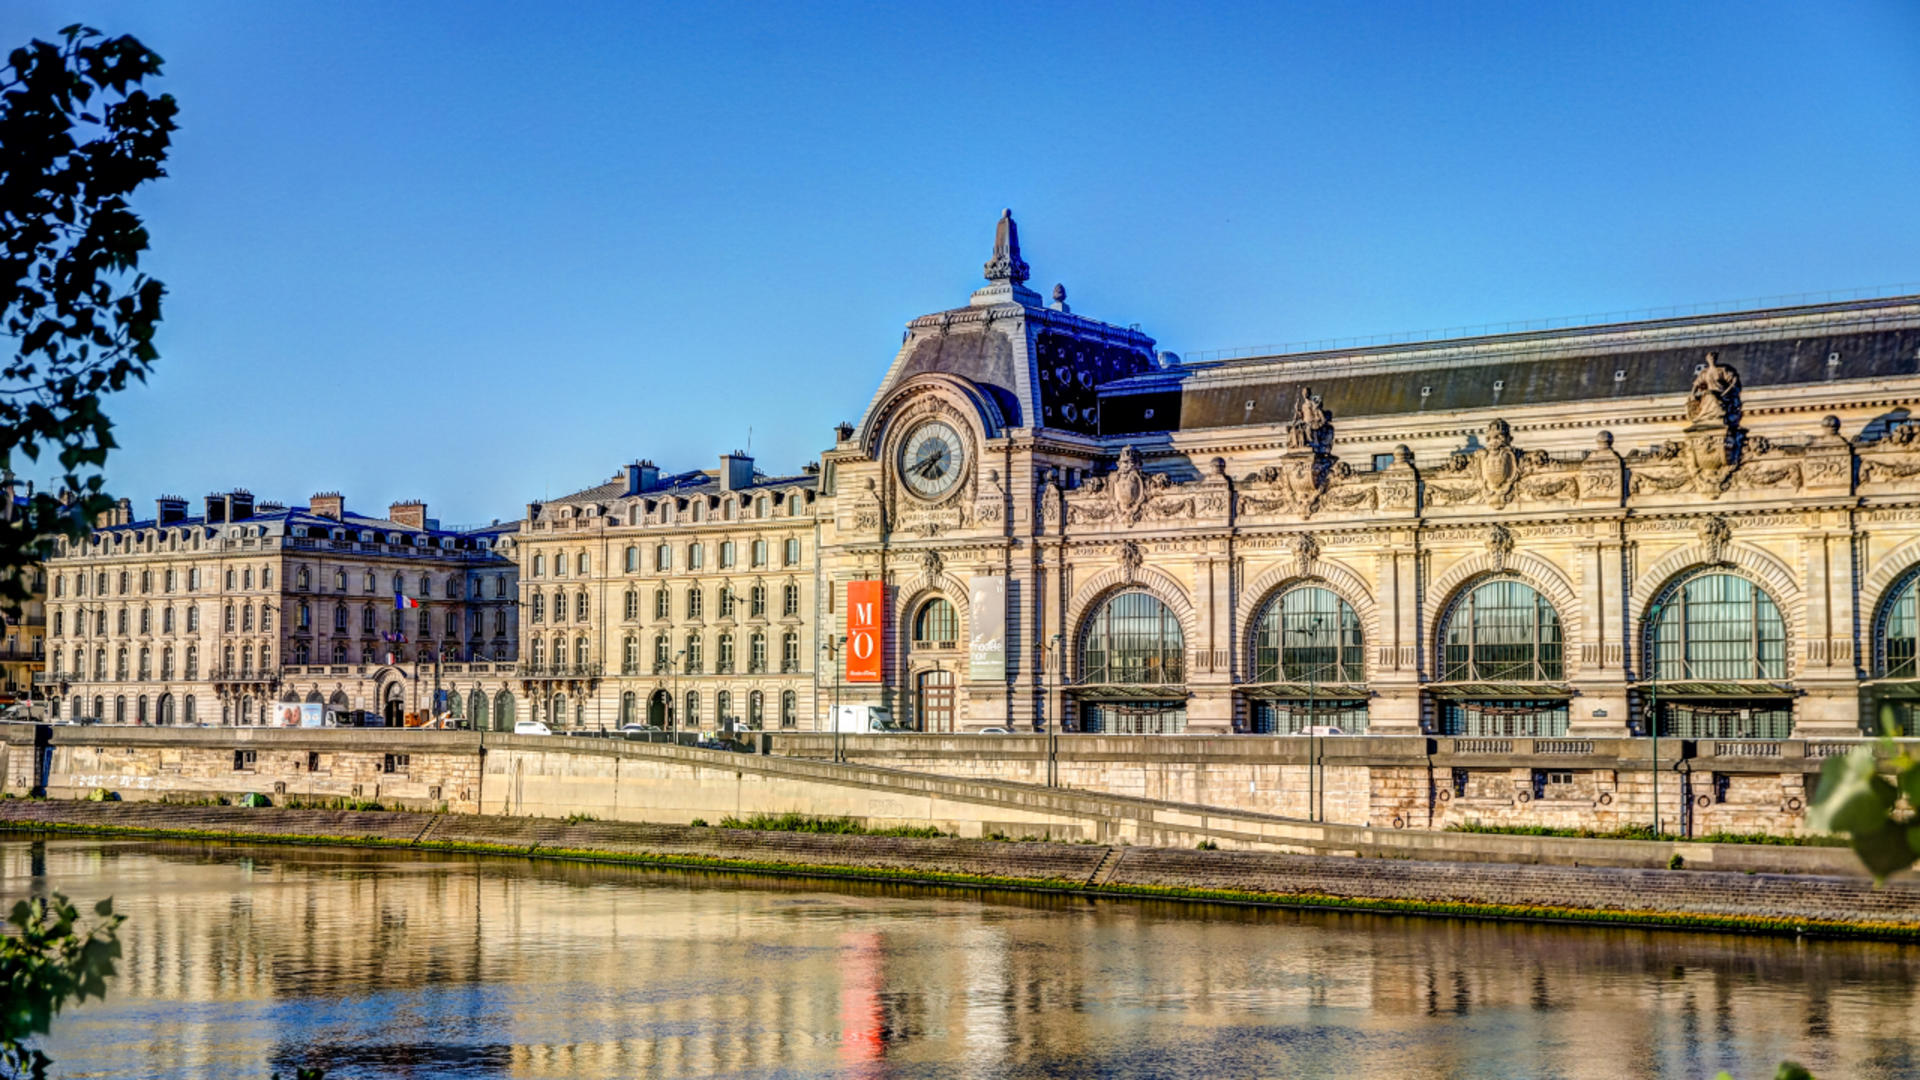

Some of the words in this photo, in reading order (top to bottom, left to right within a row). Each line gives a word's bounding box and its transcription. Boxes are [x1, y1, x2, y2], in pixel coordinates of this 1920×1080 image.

[1738, 515, 1799, 527] TOULOUSE
[1522, 526, 1574, 536] BOURGES
[1327, 535, 1373, 545] LIMOGES
[856, 603, 873, 626] M
